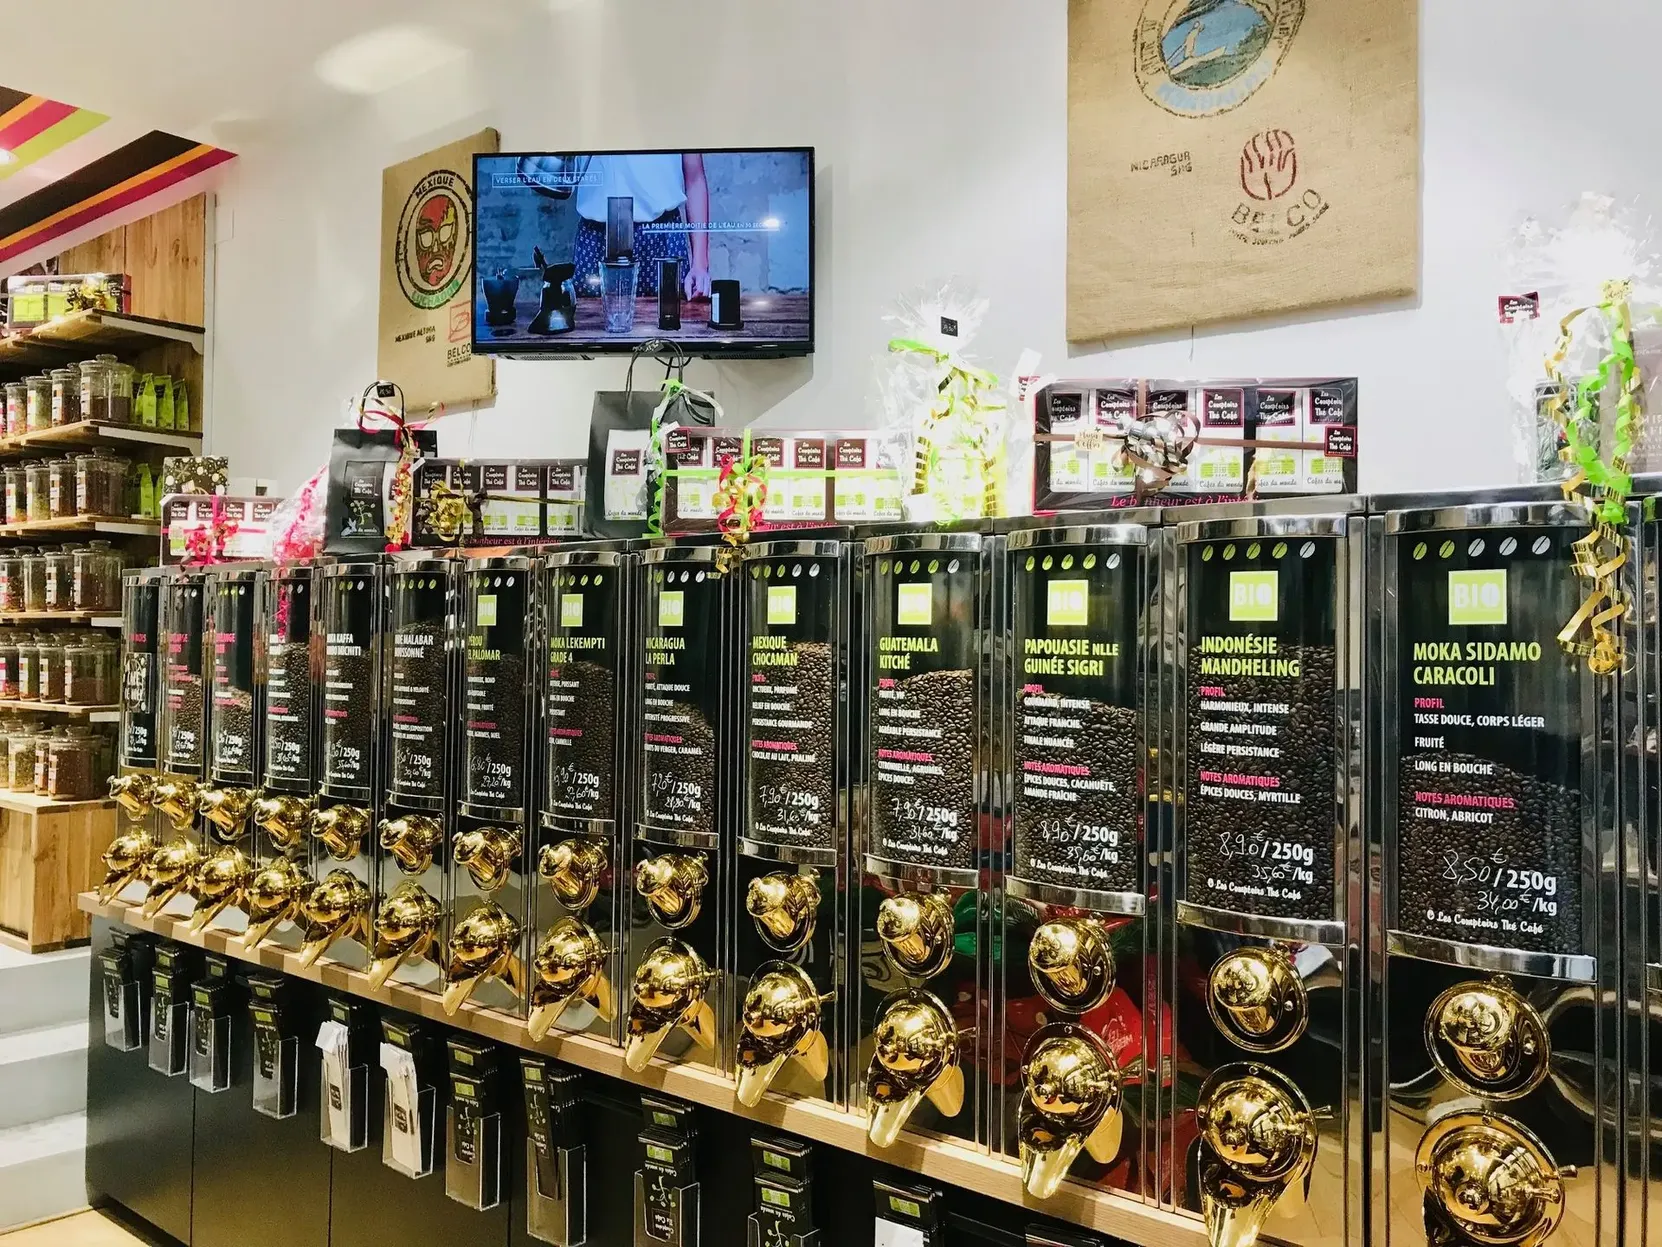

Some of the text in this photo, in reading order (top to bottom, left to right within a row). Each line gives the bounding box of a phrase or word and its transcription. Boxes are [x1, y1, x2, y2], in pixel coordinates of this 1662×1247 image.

[1130, 151, 1191, 172] NICARAGUA
[496, 175, 521, 184] VERSER
[415, 176, 454, 199] MEXIQUE
[1231, 189, 1321, 227] BECO
[642, 222, 650, 230] LA
[652, 221, 683, 230] PREMIÈRE
[709, 222, 717, 230] DE
[718, 222, 736, 230] L'EAU
[447, 342, 471, 359] BELCO
[1101, 401, 1130, 409] Comptoirs
[1153, 402, 1183, 411] Comptoirs
[1208, 401, 1238, 410] Comptoirs
[1260, 402, 1289, 411] Comptoirs
[1315, 408, 1326, 416] Thé
[1208, 411, 1238, 421] Thé Café
[1339, 443, 1352, 451] Café
[1111, 496, 1126, 507] Le
[1129, 495, 1182, 507] bnheur
[1185, 497, 1202, 505] est
[1234, 583, 1272, 606] BIO
[1454, 582, 1500, 609] BIO
[661, 600, 681, 615] BIO
[566, 637, 605, 649] LEKEMPTI
[646, 637, 685, 649] NICARAGUA
[753, 636, 786, 650] MEXIQUE
[879, 637, 938, 652] GUATEMALA
[1024, 638, 1119, 656] PAPOUASIE NLLE
[1201, 633, 1277, 654] INDONÉSIE
[472, 650, 500, 660] PALOMAR
[568, 652, 573, 664] 4
[646, 653, 675, 665] LA PERLA
[1413, 641, 1542, 662] MOKA SIDAMO
[753, 653, 798, 666] CHOCAMAN
[879, 653, 910, 669] KITCHÉ
[1024, 656, 1104, 676] GUINÉE SIGRI
[1201, 658, 1300, 677] MANDHELING
[1413, 666, 1495, 686] CARACOLI
[1201, 686, 1225, 697] PROFIL
[1201, 701, 1289, 714] HARMONIEUX, INTENSE
[1414, 697, 1444, 709] PROFIL
[1414, 713, 1545, 728] TASSE DOUCE, CORPS LÉGER
[1201, 722, 1277, 736] GRANDE AMPLITUDE
[1414, 736, 1444, 749] FRUITÉ
[1201, 743, 1279, 758] LÉGÈRE PERSISTANCE
[1415, 760, 1493, 775] LONG EN BOUCHE
[1201, 770, 1280, 787] NOTES AROMATIQUES
[1201, 785, 1300, 803] ÉPICES DOUCES, MYRTILLE
[1415, 791, 1514, 809] NOTES AROMATIQUES
[1415, 808, 1493, 824] CITRON, ABRICOT
[1454, 914, 1498, 930] Comptoirs
[1501, 919, 1517, 930] Thé
[1520, 920, 1543, 934] Café
